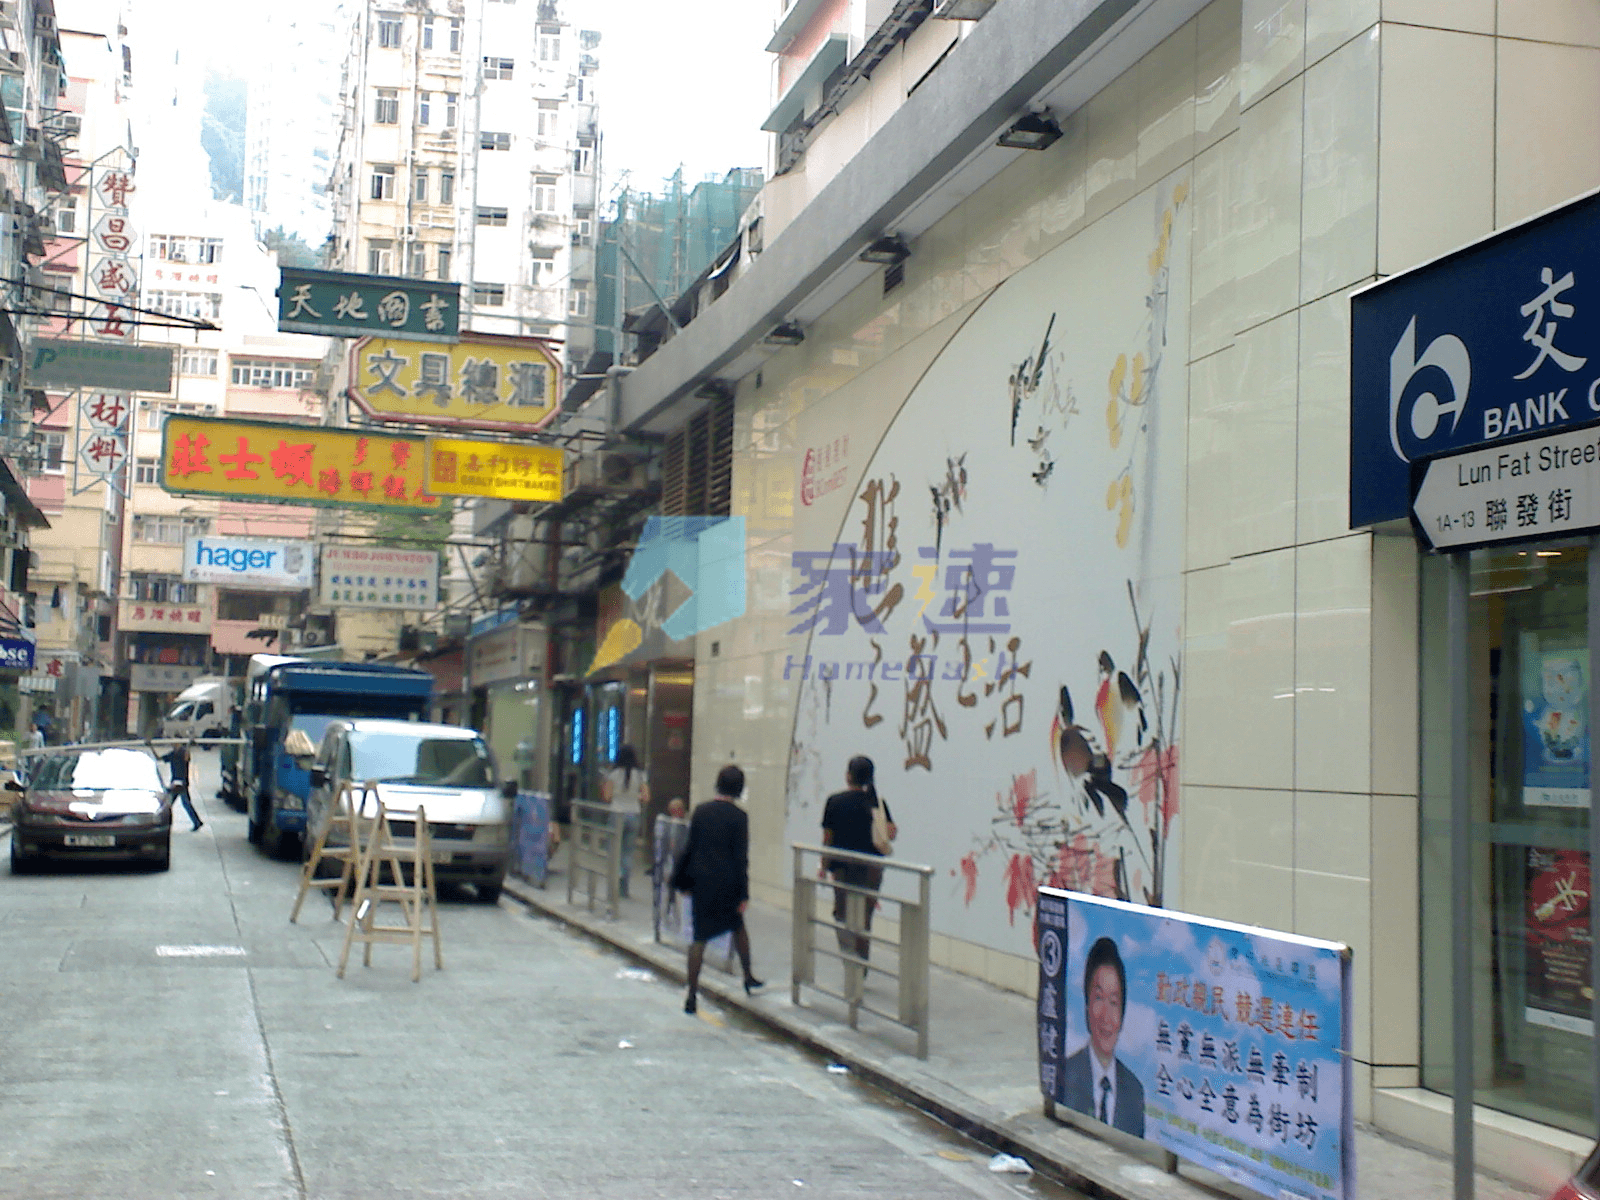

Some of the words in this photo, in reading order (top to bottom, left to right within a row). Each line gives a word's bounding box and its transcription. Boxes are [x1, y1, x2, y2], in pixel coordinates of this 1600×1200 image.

[86, 173, 136, 471] 贊昌盛五材料
[287, 283, 450, 331] 天地圖書
[1484, 388, 1570, 440] BANK
[1458, 464, 1491, 487] Lun
[1498, 452, 1531, 480] Fat
[1436, 511, 1475, 532] 1A-13
[1485, 488, 1572, 532] 聯發街
[196, 540, 278, 572] hager
